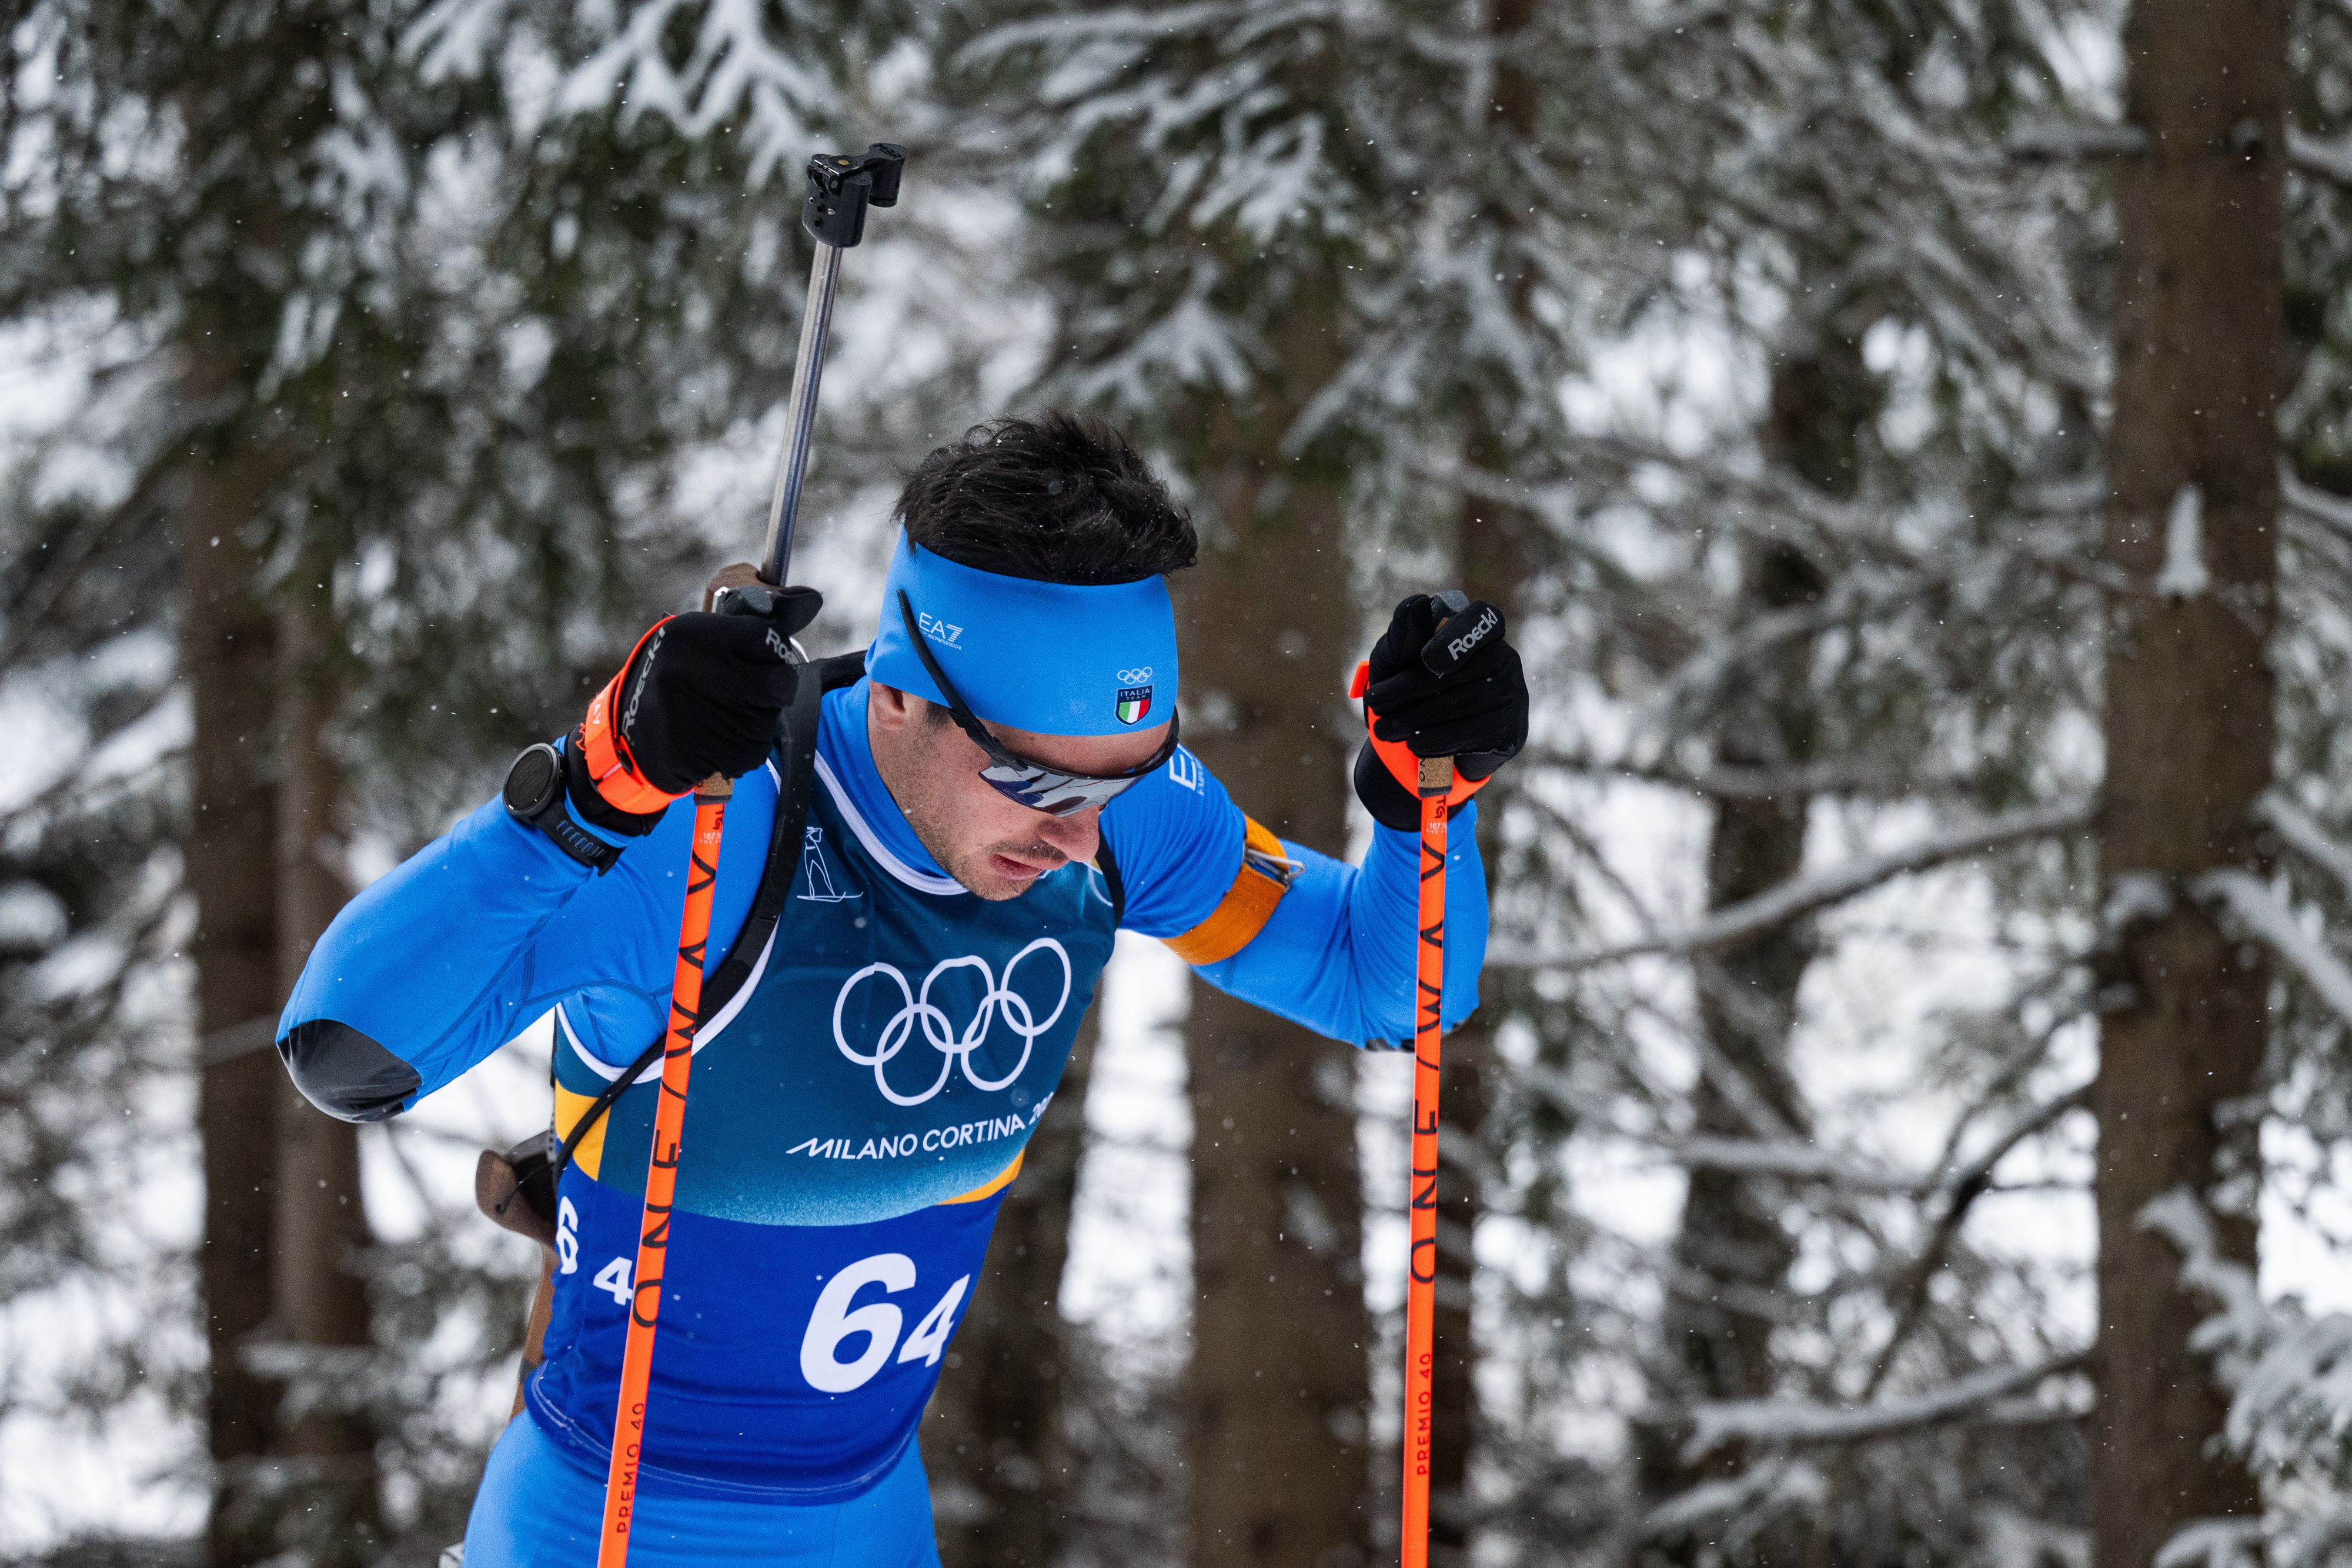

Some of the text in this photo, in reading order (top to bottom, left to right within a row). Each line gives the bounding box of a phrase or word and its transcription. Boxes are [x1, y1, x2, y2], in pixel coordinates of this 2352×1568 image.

[918, 611, 964, 643] EA7
[1120, 688, 1150, 697] ITALIA
[785, 1134, 918, 1160] MILANO
[922, 1113, 1026, 1152] CORTINA
[800, 1252, 970, 1393] 64
[1416, 1353, 1431, 1476] PREMIO 40
[616, 1402, 645, 1533] PREMIO 40
